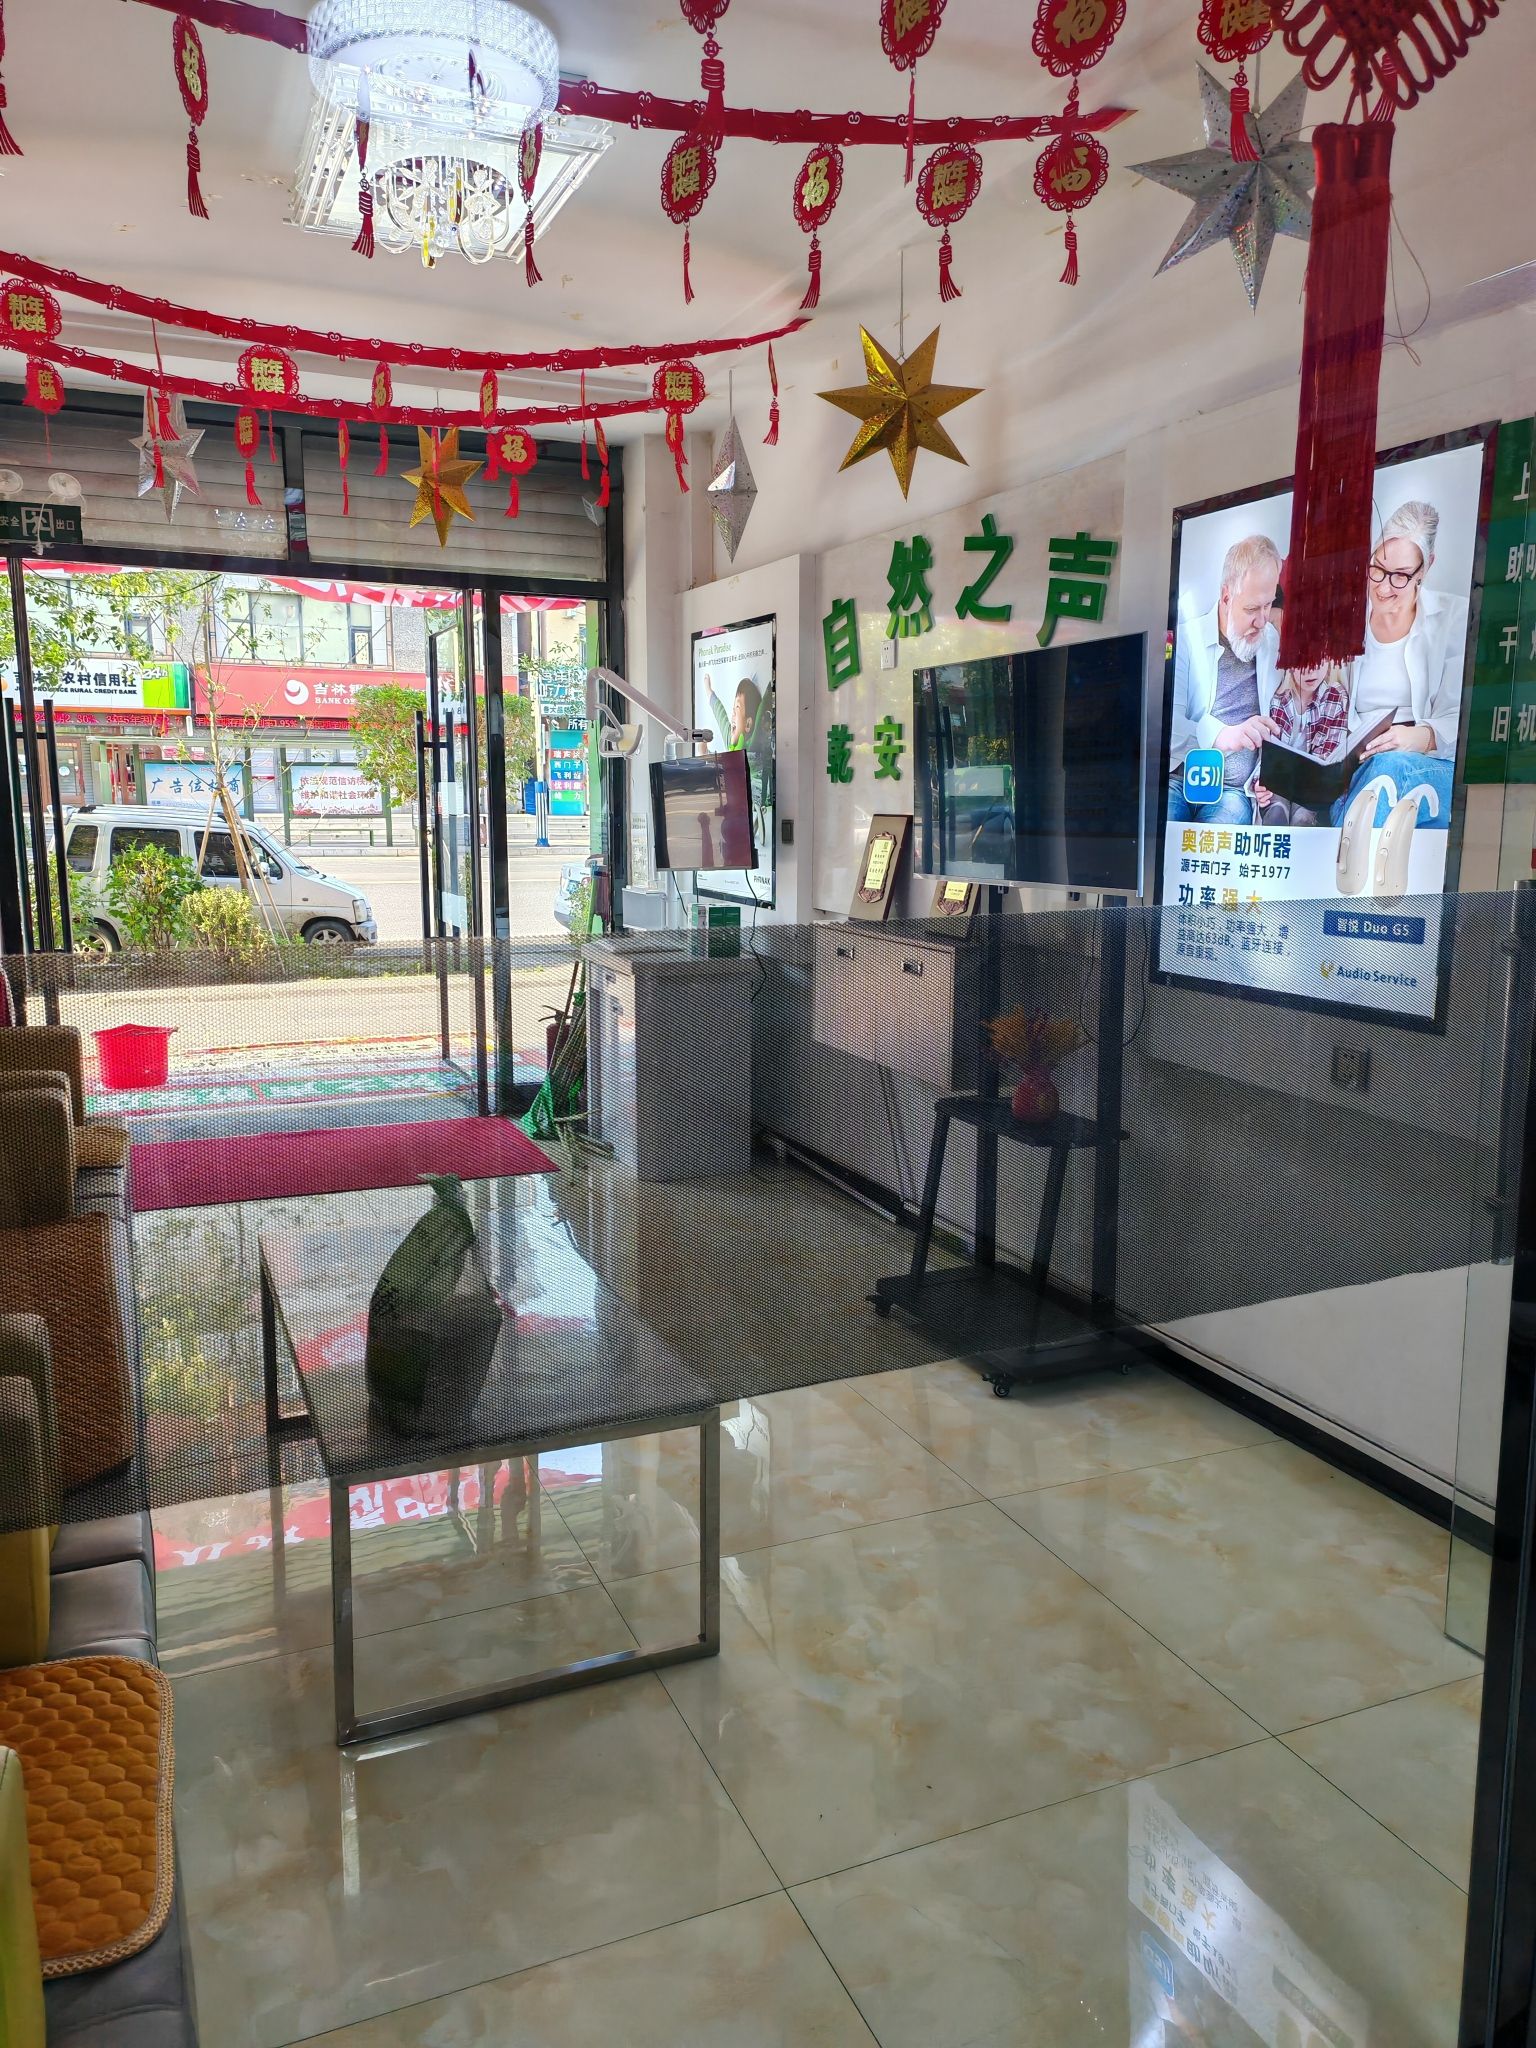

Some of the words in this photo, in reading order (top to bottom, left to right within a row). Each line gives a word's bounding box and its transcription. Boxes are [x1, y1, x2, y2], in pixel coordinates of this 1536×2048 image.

[501, 434, 527, 463] 福
[0, 515, 20, 527] 安全
[56, 519, 75, 531] 出口
[822, 513, 1118, 692] 自然之声
[1181, 828, 1292, 859] 奥德声助听器
[1180, 858, 1231, 876] 源于西门子
[1239, 862, 1291, 879] 始于1977
[1363, 920, 1388, 934] Duo
[1392, 923, 1410, 937] G5
[1336, 965, 1371, 981] Audio
[1373, 970, 1419, 988] Service
